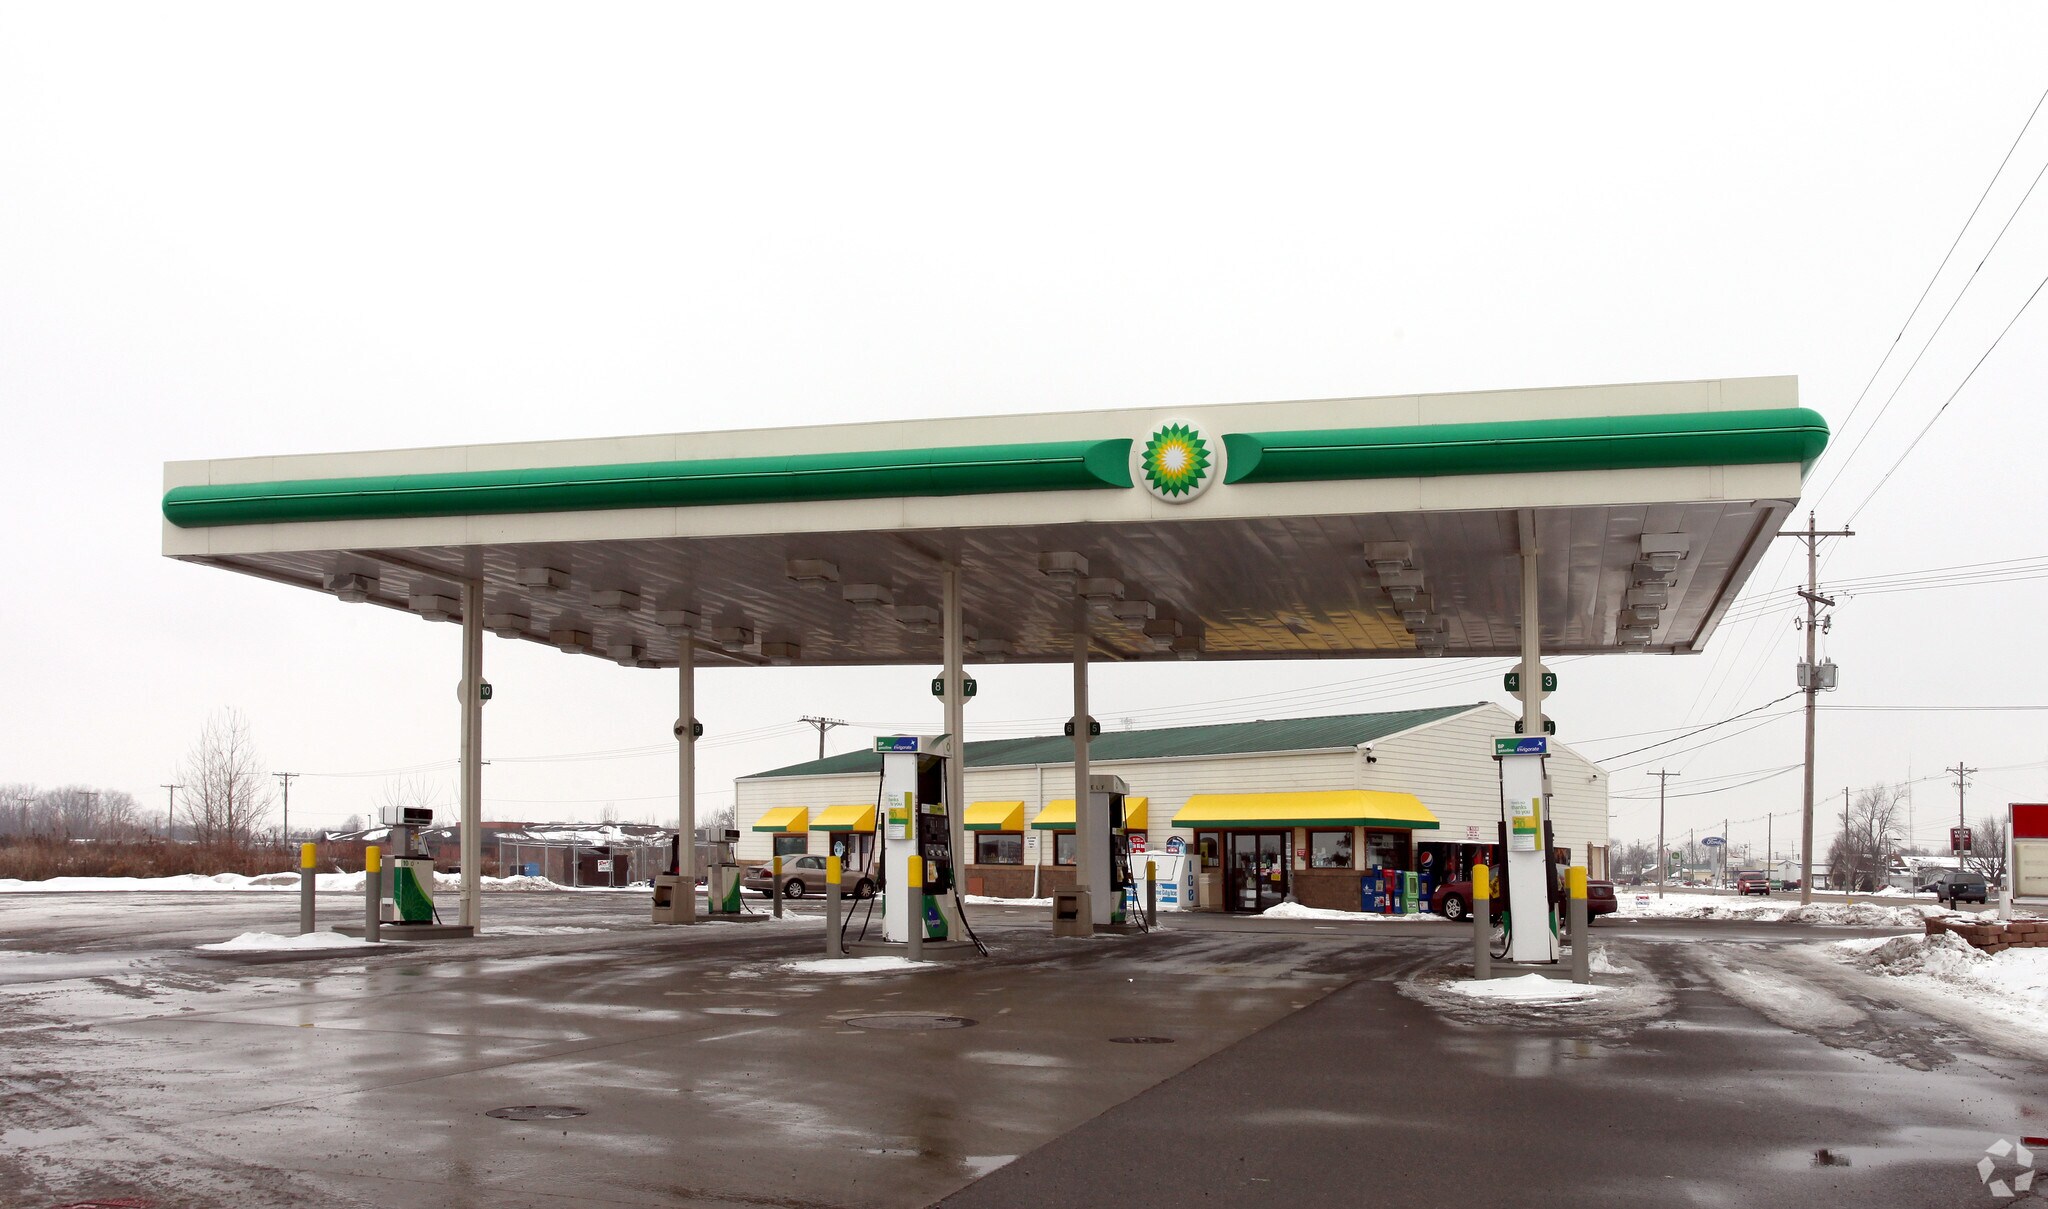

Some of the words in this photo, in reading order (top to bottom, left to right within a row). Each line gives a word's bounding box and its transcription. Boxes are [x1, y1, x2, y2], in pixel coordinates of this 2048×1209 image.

[1508, 676, 1516, 686] 4
[1545, 676, 1553, 687] 3
[481, 686, 491, 695] 10
[935, 681, 941, 692] 8
[966, 682, 973, 692] 7
[1092, 724, 1098, 733] 5
